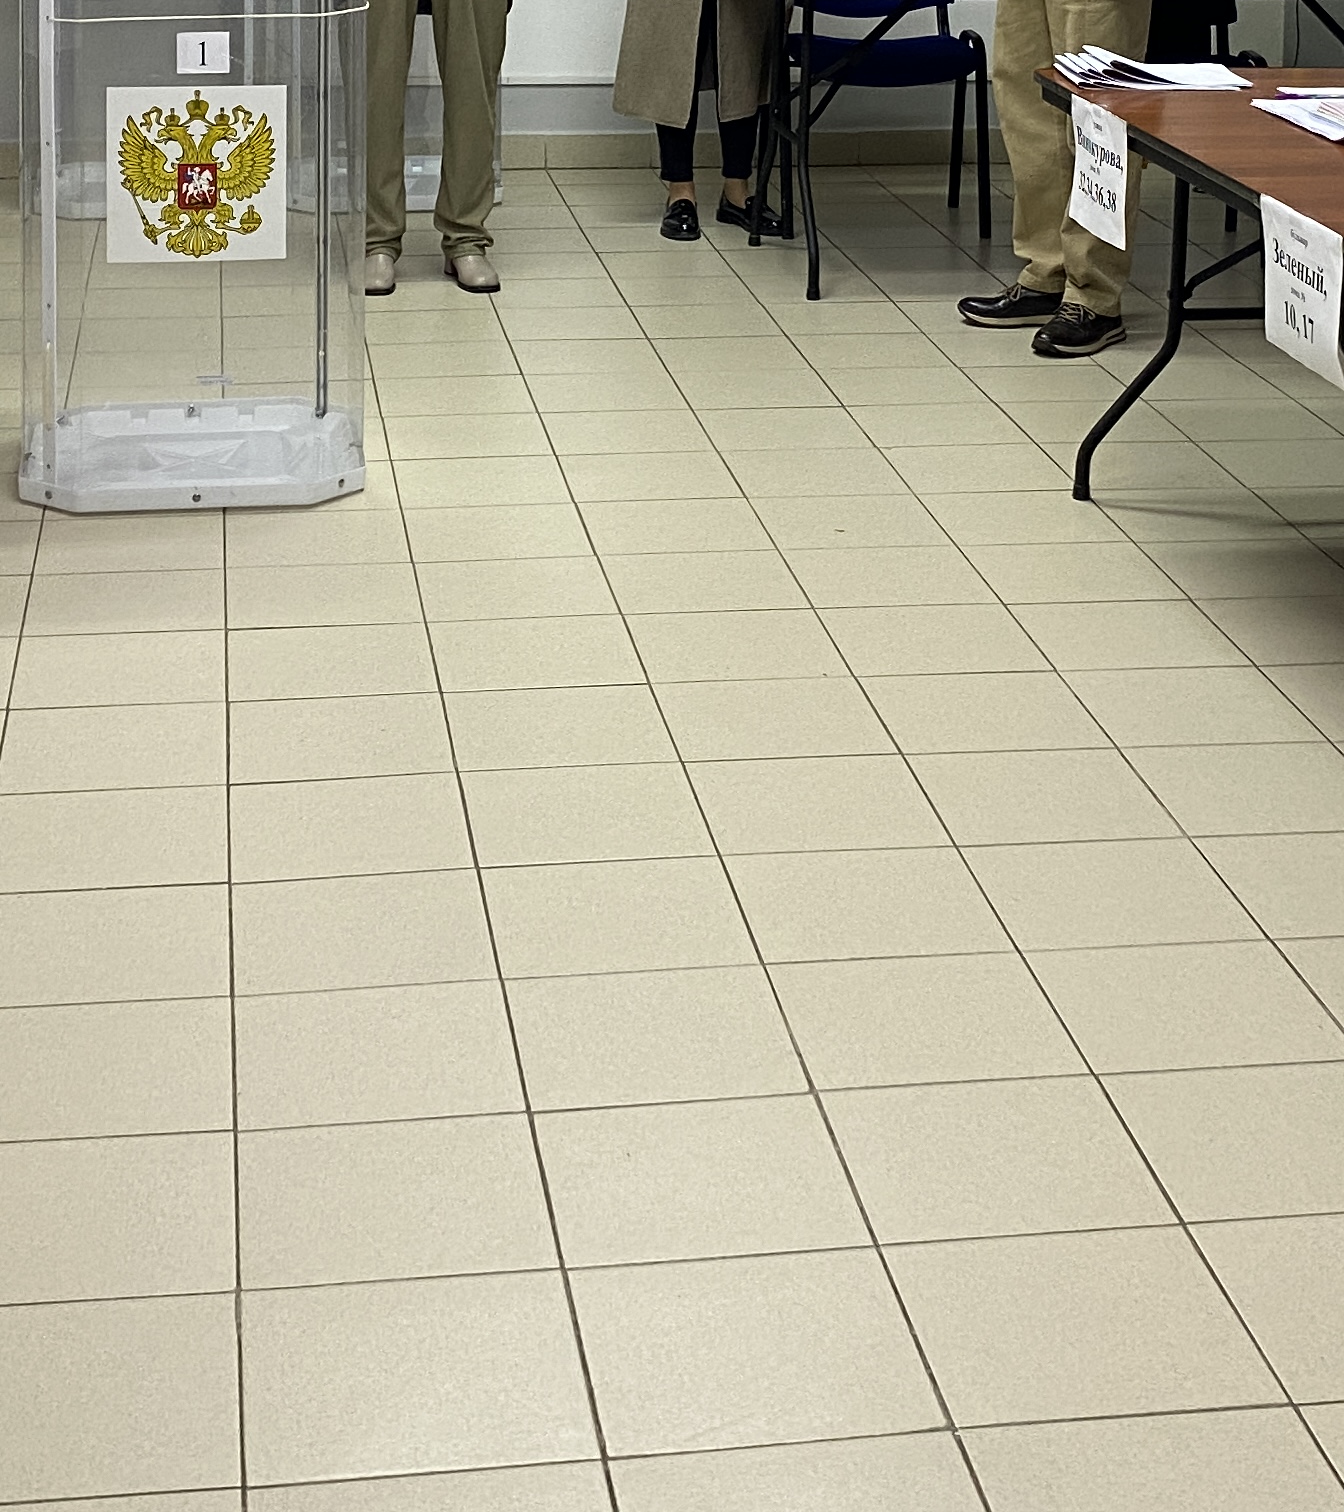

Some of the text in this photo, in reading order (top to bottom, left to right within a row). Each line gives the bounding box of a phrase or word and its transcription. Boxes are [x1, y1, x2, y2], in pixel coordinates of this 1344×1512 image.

[197, 40, 209, 67] 1
[1272, 237, 1328, 302] Зеленый,
[1284, 300, 1314, 344] 10, 17
